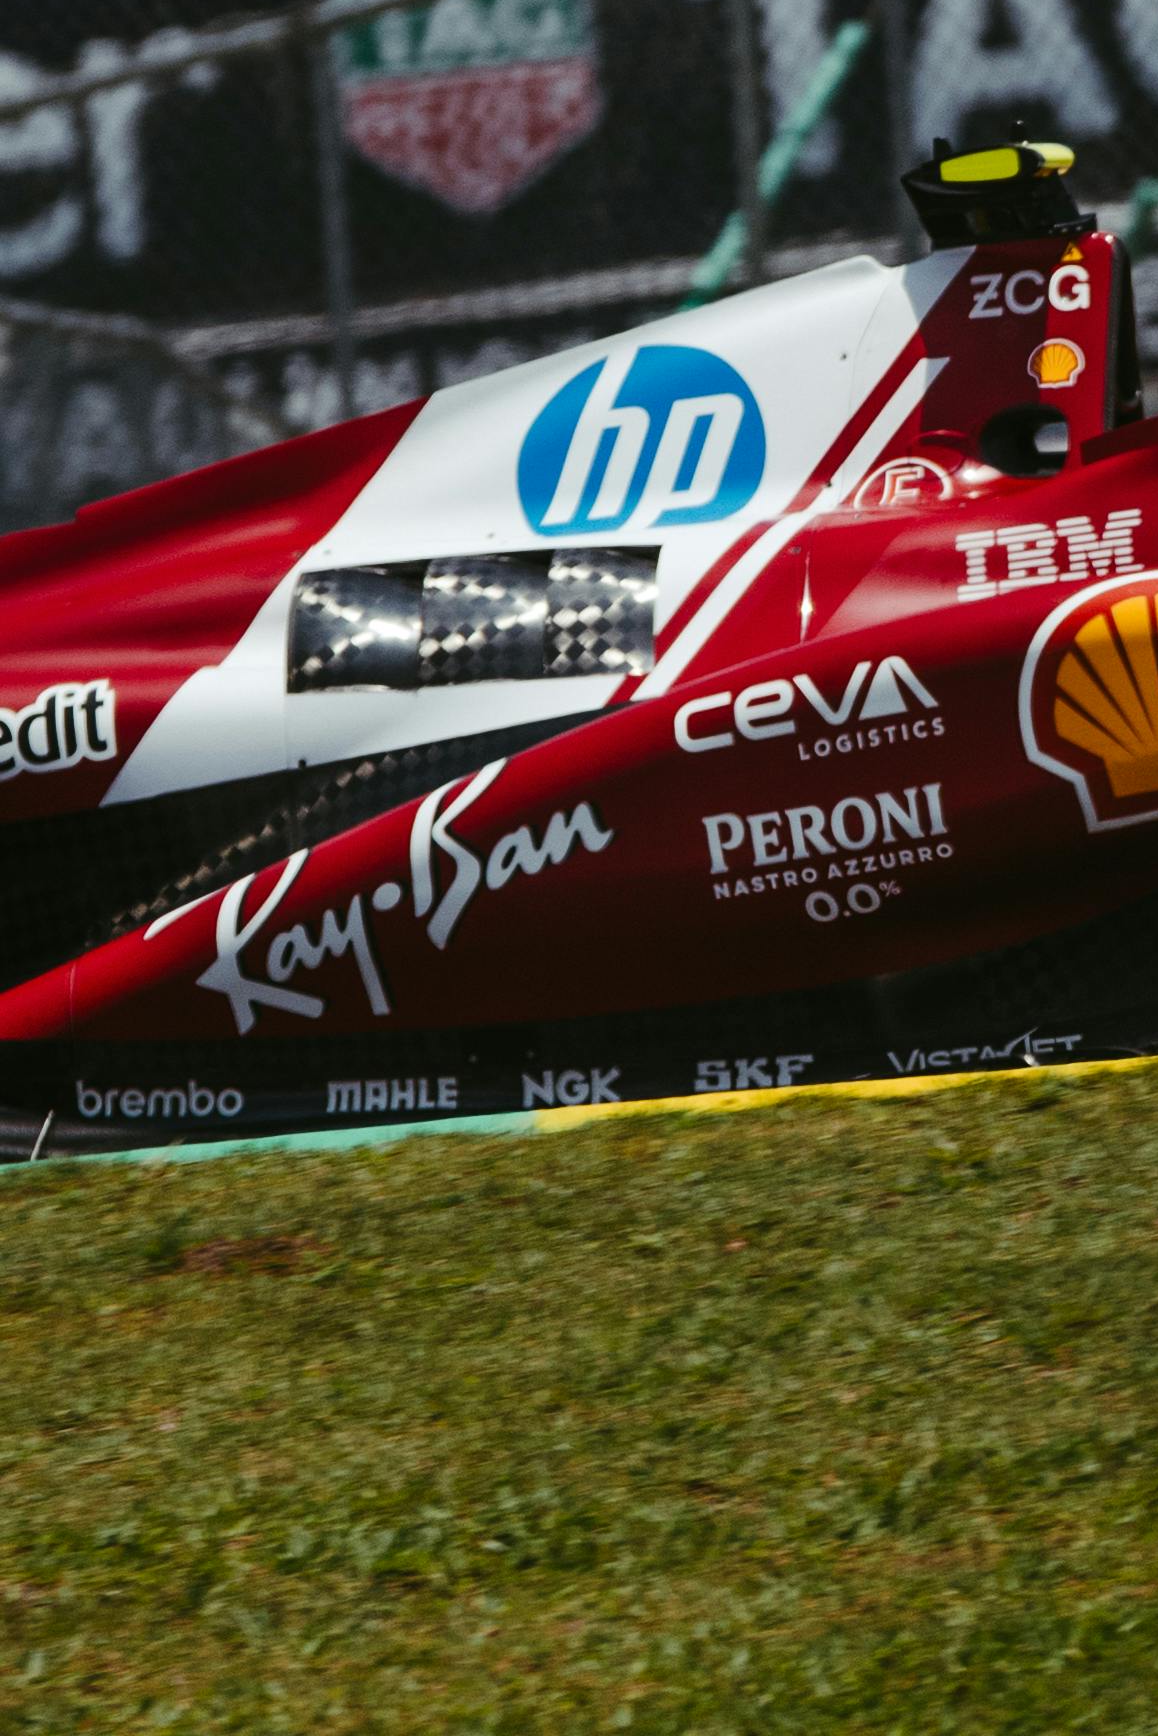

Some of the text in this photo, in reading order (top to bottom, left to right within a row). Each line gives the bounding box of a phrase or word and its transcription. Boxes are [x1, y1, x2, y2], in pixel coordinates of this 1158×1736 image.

[968, 263, 1091, 320] ZCG
[538, 342, 746, 533] hp
[954, 507, 1145, 603] IBM
[797, 717, 946, 762] LOGISTICS
[701, 781, 948, 875] PERONI
[713, 843, 954, 900] NASTRO AZZURRO
[804, 879, 902, 923] 0.0%
[325, 1075, 458, 1114] MAHLE
[521, 1067, 622, 1108] NGK
[693, 1054, 815, 1093] SKF
[76, 1079, 245, 1118] brembo
